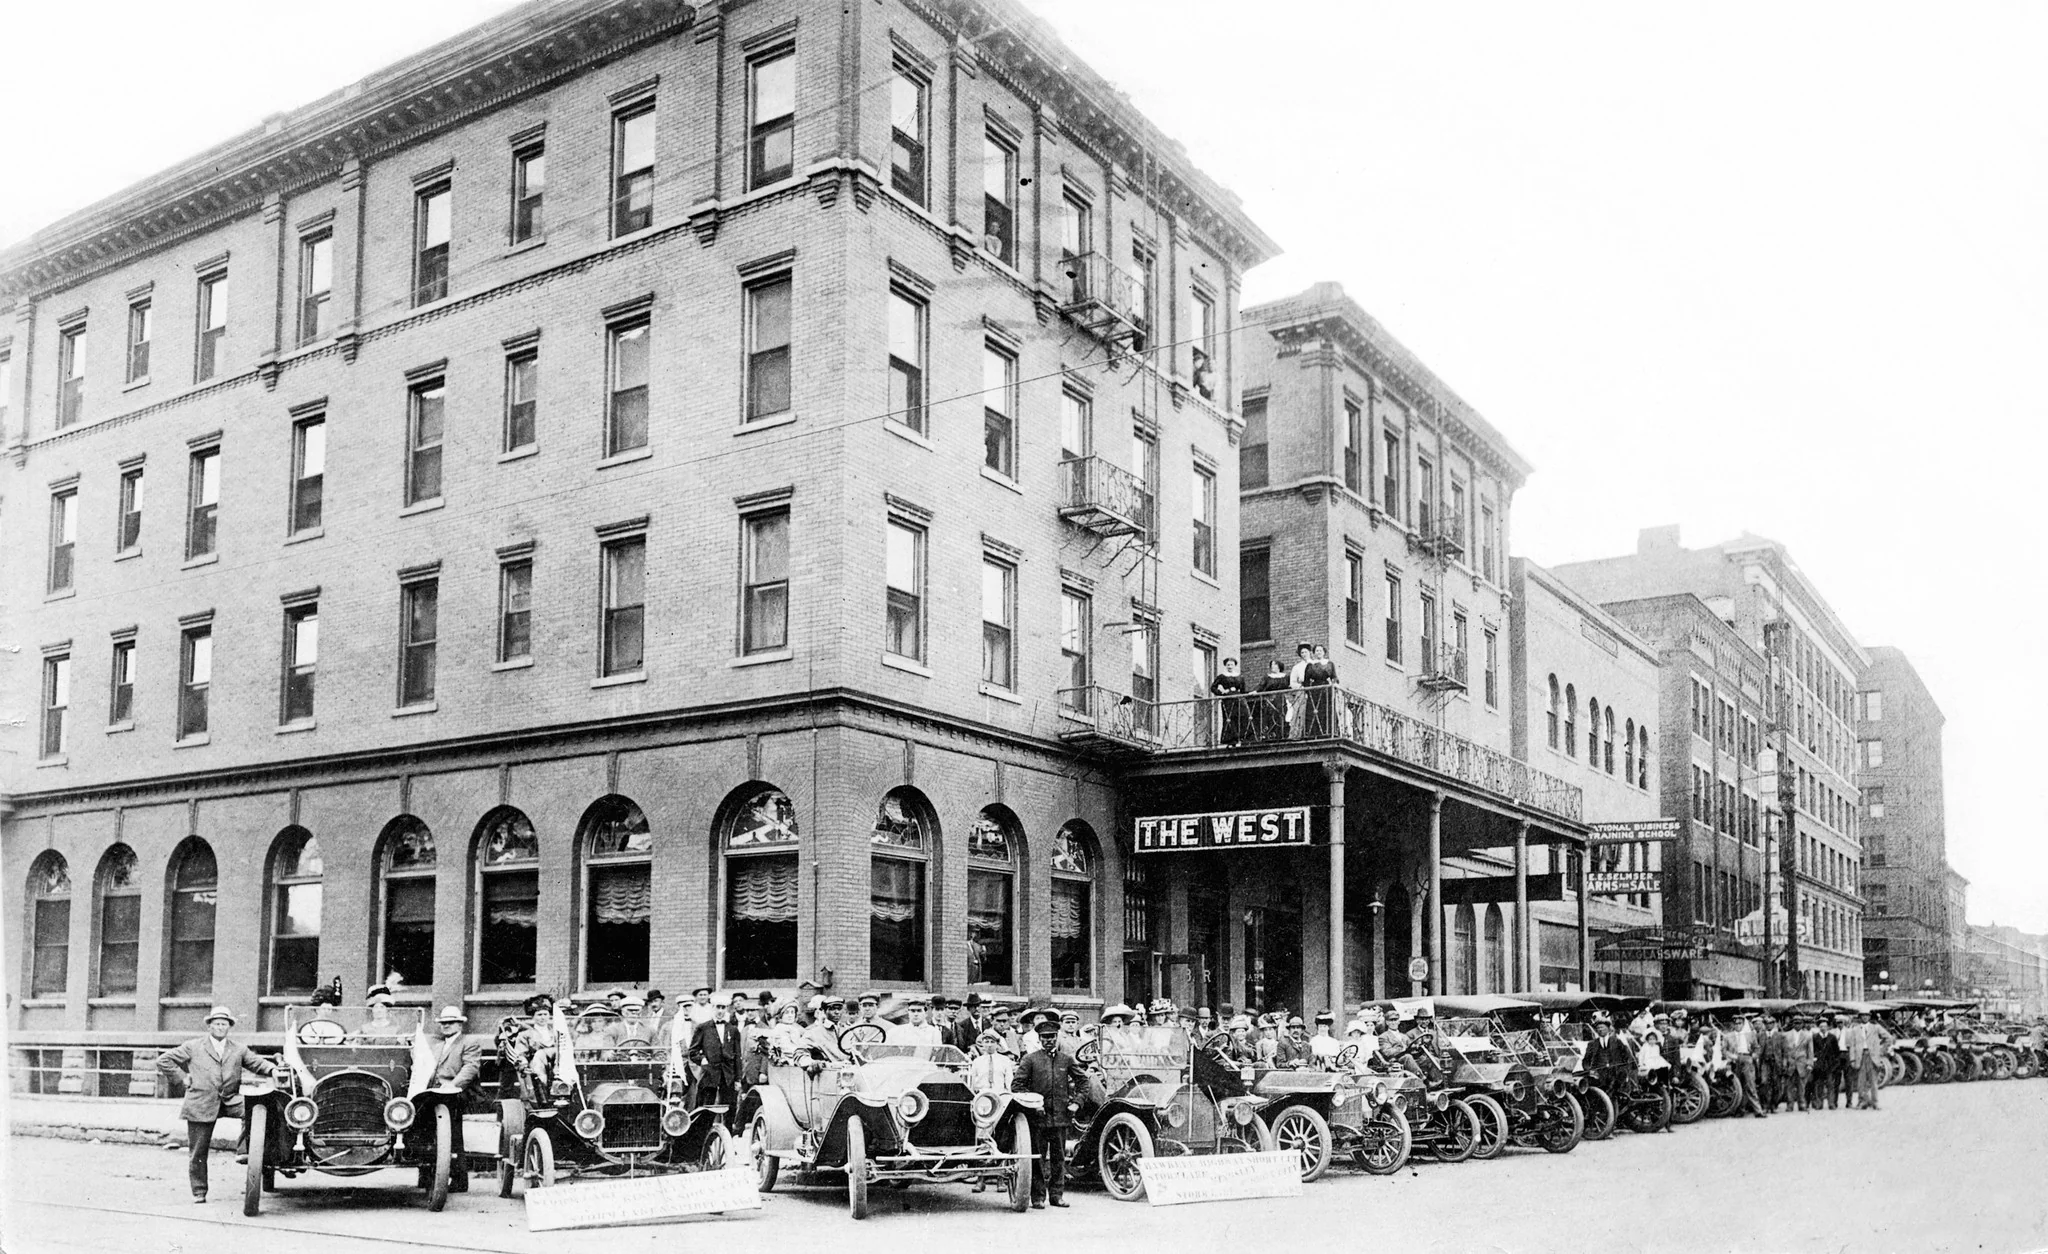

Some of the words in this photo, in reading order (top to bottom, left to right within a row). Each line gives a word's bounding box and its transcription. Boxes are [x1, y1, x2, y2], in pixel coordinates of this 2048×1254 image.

[1140, 818, 1199, 846] THE
[1211, 812, 1302, 843] WEST
[1634, 822, 1681, 831] BUSINESS
[1638, 830, 1677, 839] SCHOOL
[1630, 880, 1661, 891] SALE
[1635, 949, 1703, 959] GLASSWARE
